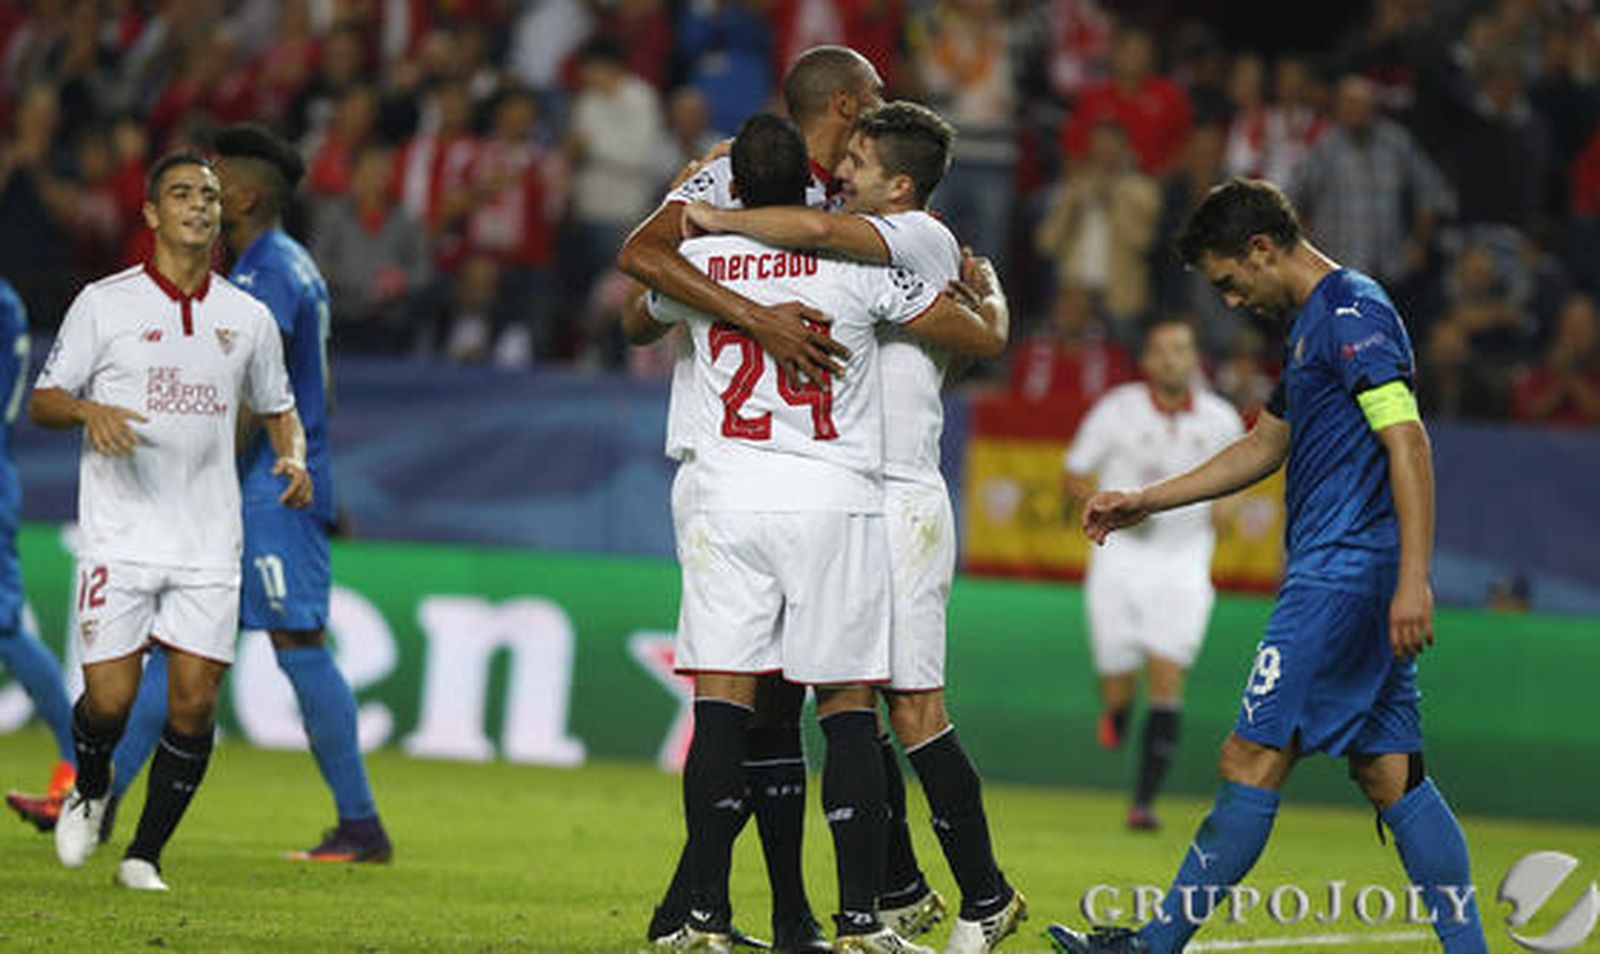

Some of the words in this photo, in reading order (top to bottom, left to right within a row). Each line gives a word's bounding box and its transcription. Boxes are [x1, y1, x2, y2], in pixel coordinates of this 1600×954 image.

[146, 382, 218, 400] PUERTO
[707, 320, 840, 441] 24
[78, 565, 109, 613] 12
[253, 553, 288, 600] 11
